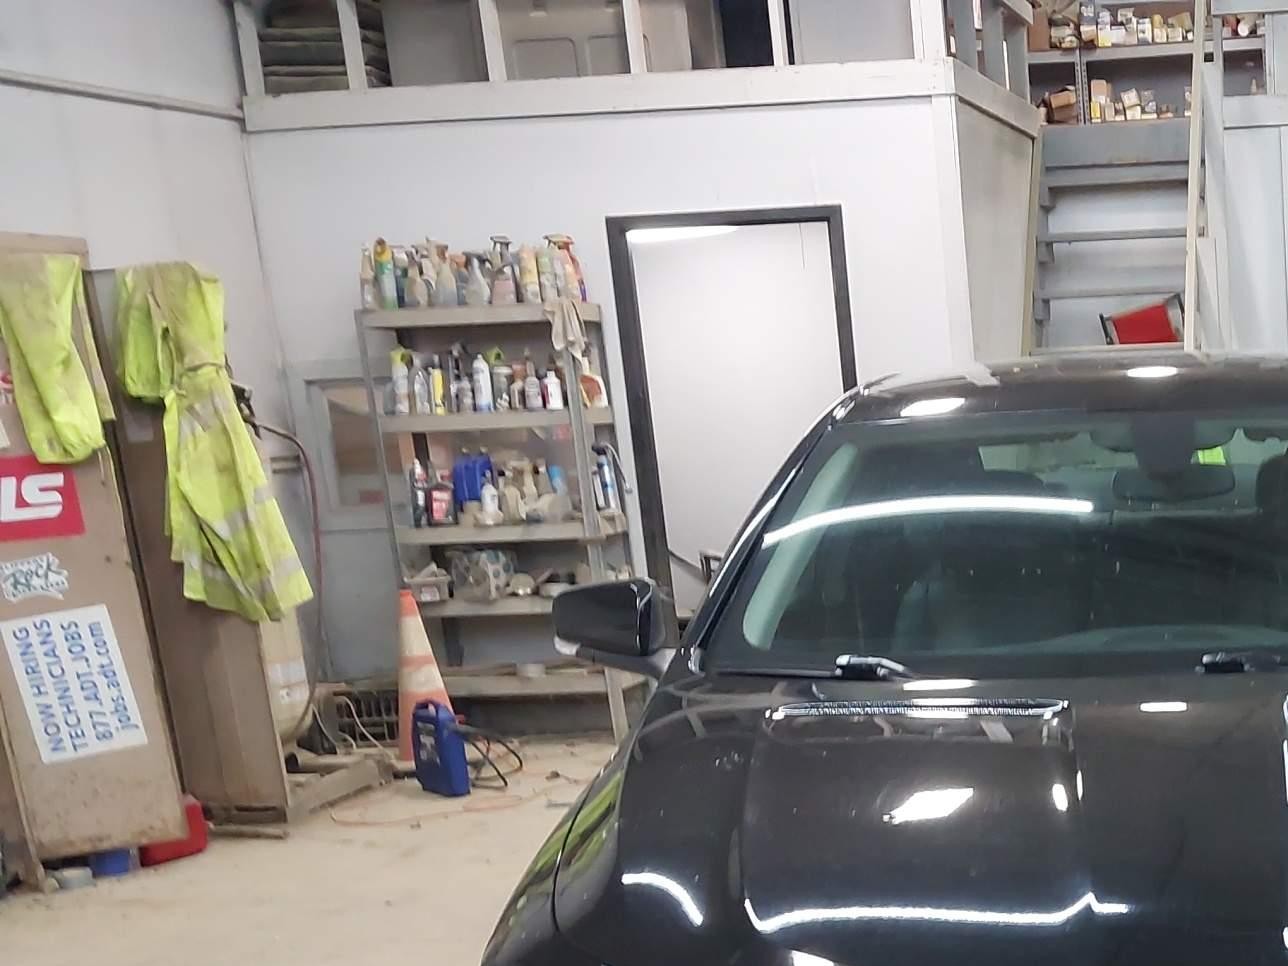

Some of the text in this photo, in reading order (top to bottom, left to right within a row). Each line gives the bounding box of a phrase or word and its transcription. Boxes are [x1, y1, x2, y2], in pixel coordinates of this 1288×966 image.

[12, 626, 49, 698] HIRING
[33, 618, 88, 752] TECHNICIANS
[88, 621, 140, 732] jobs.adt.com
[36, 702, 67, 753] NOW
